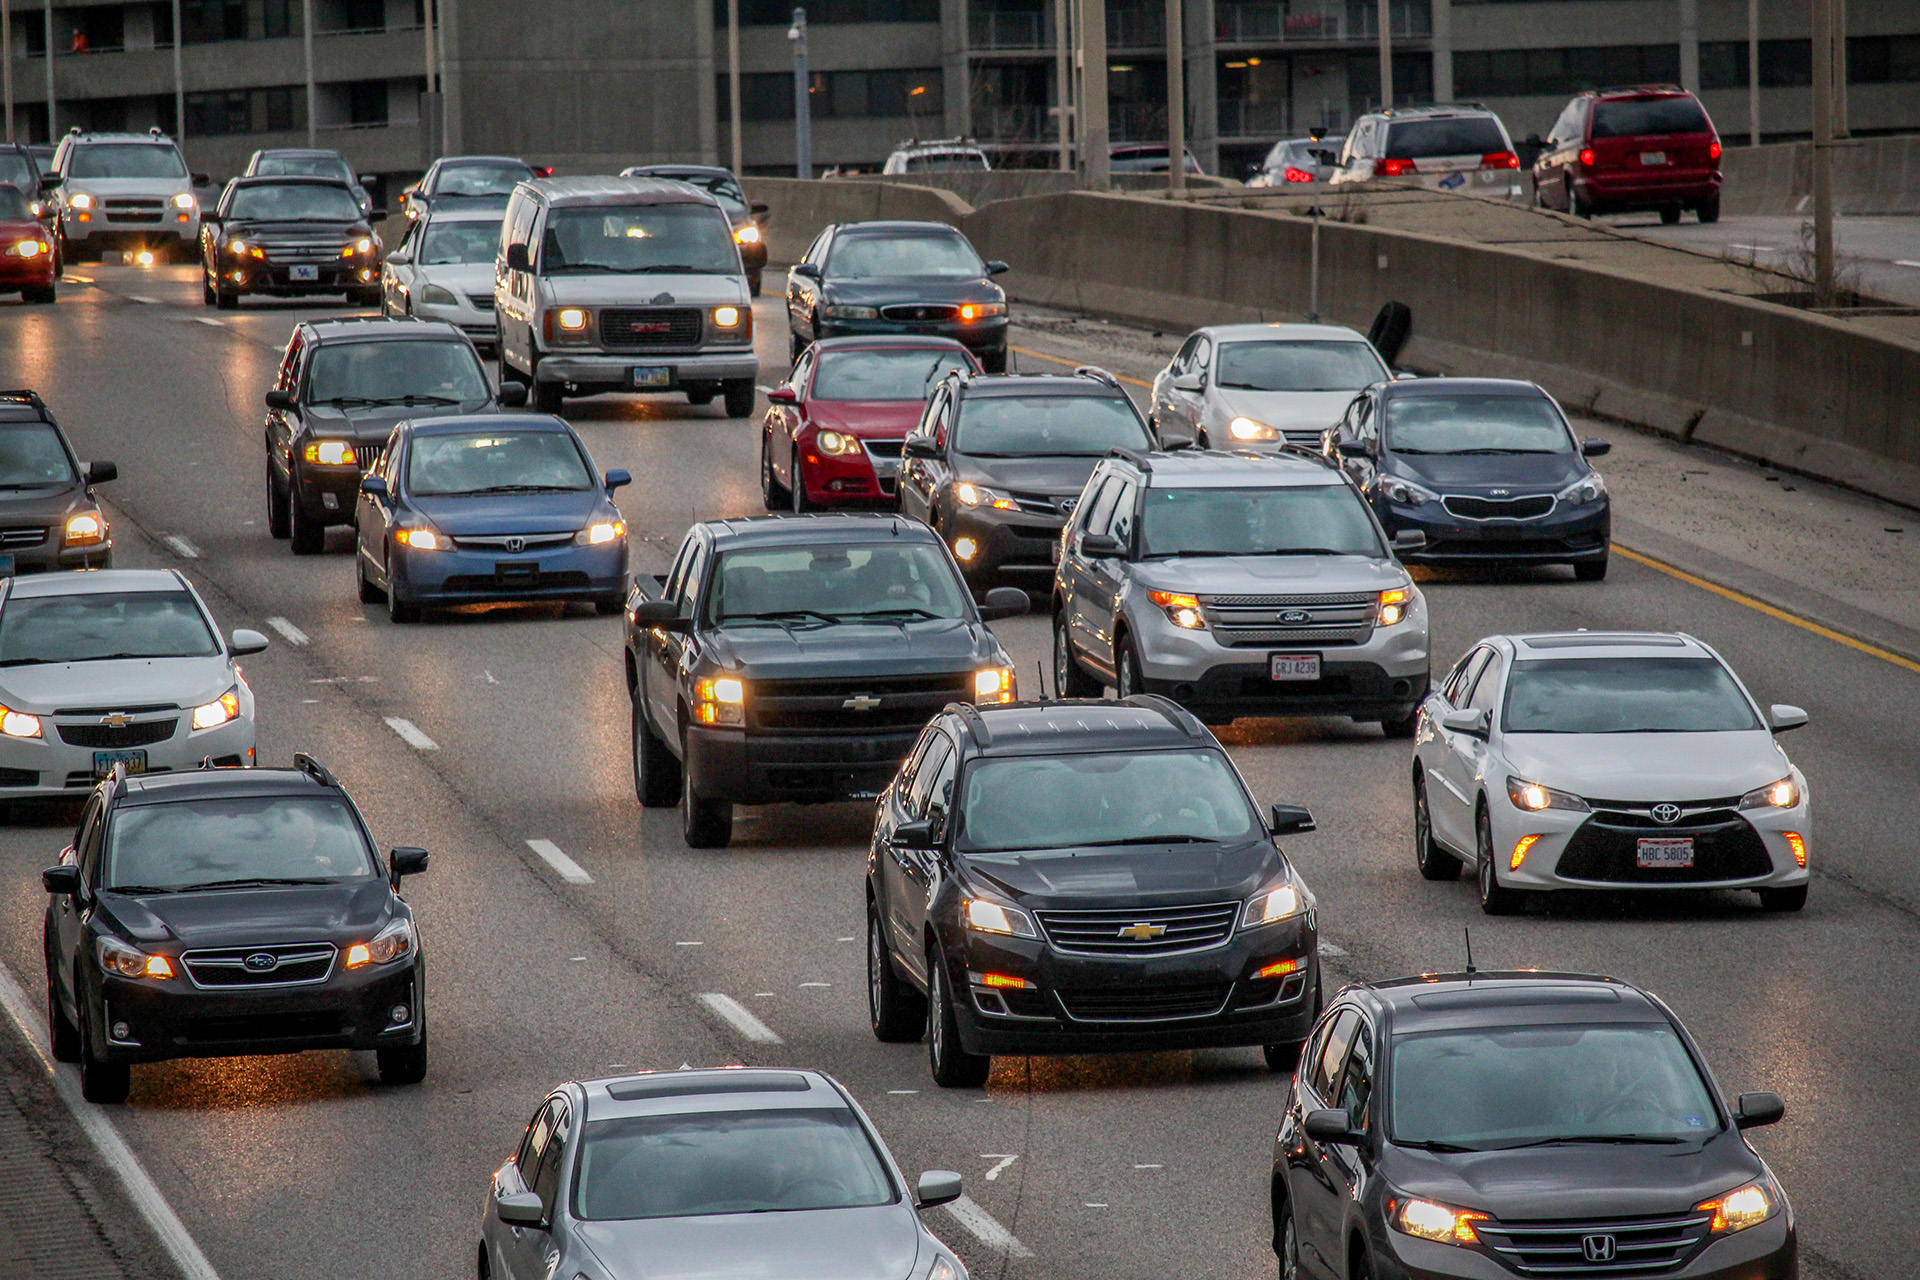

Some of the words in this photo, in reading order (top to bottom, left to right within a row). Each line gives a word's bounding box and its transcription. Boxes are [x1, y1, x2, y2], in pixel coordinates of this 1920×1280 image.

[631, 322, 671, 333] GMC
[1294, 662, 1317, 674] 4239
[1641, 848, 1660, 861] HBC
[1664, 847, 1690, 861] 5805
